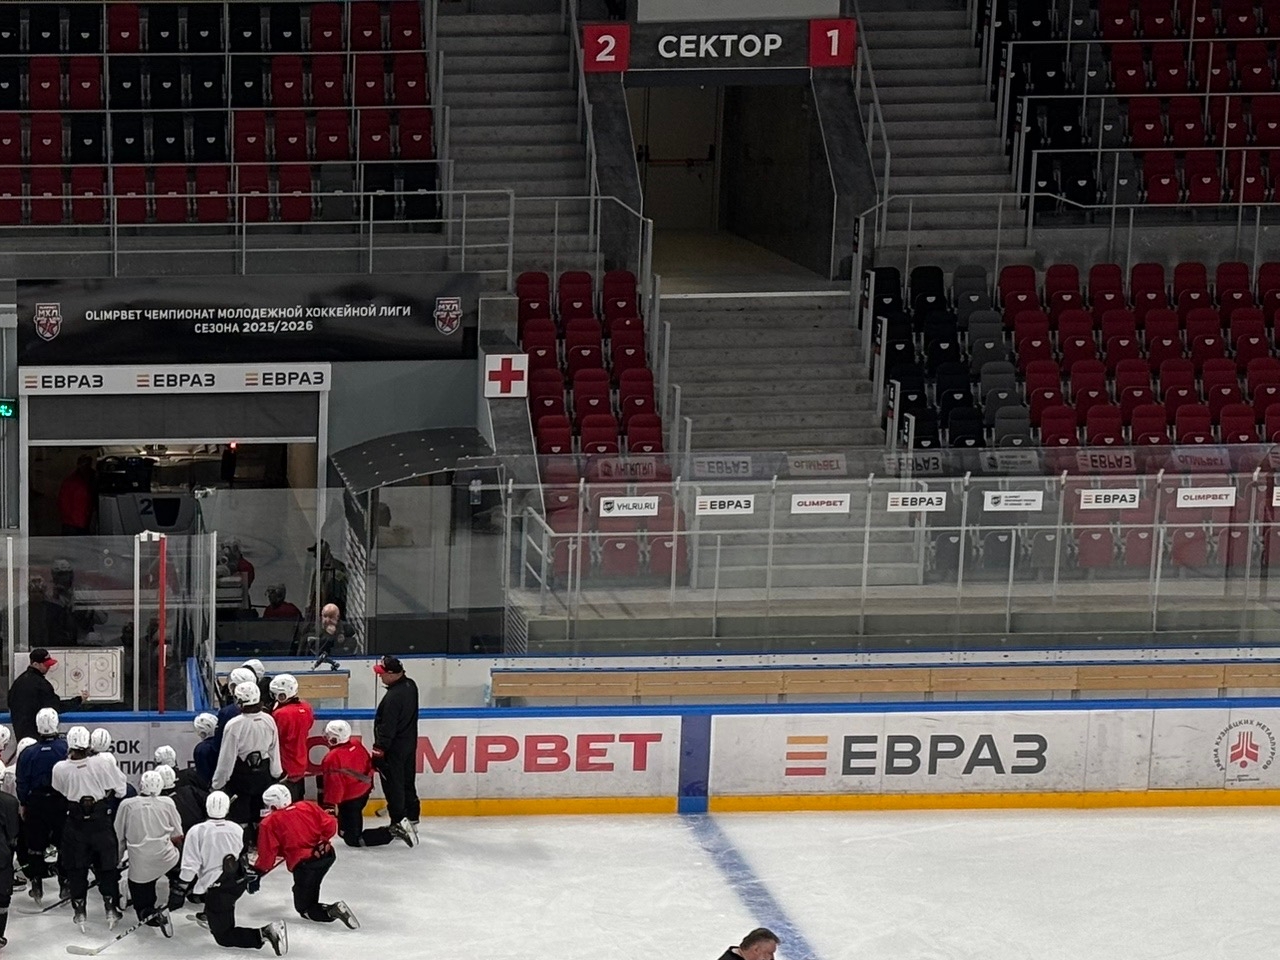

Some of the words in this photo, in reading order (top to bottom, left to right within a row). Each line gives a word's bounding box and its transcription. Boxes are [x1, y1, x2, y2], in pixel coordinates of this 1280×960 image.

[596, 35, 616, 61] 2
[658, 34, 782, 58] СЕКТОР
[826, 29, 839, 56] 1
[85, 310, 142, 320] OLIMPBET
[144, 308, 215, 320] ЧЕМПИОНАТ
[217, 305, 303, 319] МОЛОДЕЖНОЙ
[305, 304, 376, 317] ХОККЕЙНОЙ
[378, 306, 411, 317] ЛИГИ
[194, 322, 240, 334] СЕЗОНА
[242, 320, 314, 333] 2025/2026
[41, 375, 104, 389] ЕВРАЗ
[153, 374, 216, 388] ЕВРАЗ
[262, 372, 325, 386] ЕВРАЗ
[709, 500, 751, 509] ЕВРАЗ
[901, 497, 943, 506] ЕВРАЗ
[1095, 494, 1136, 503] ЕВРАЗ
[140, 498, 153, 515] 2
[617, 502, 656, 511] VHLRU.RU
[841, 734, 1048, 775] ЕВРАЗ
